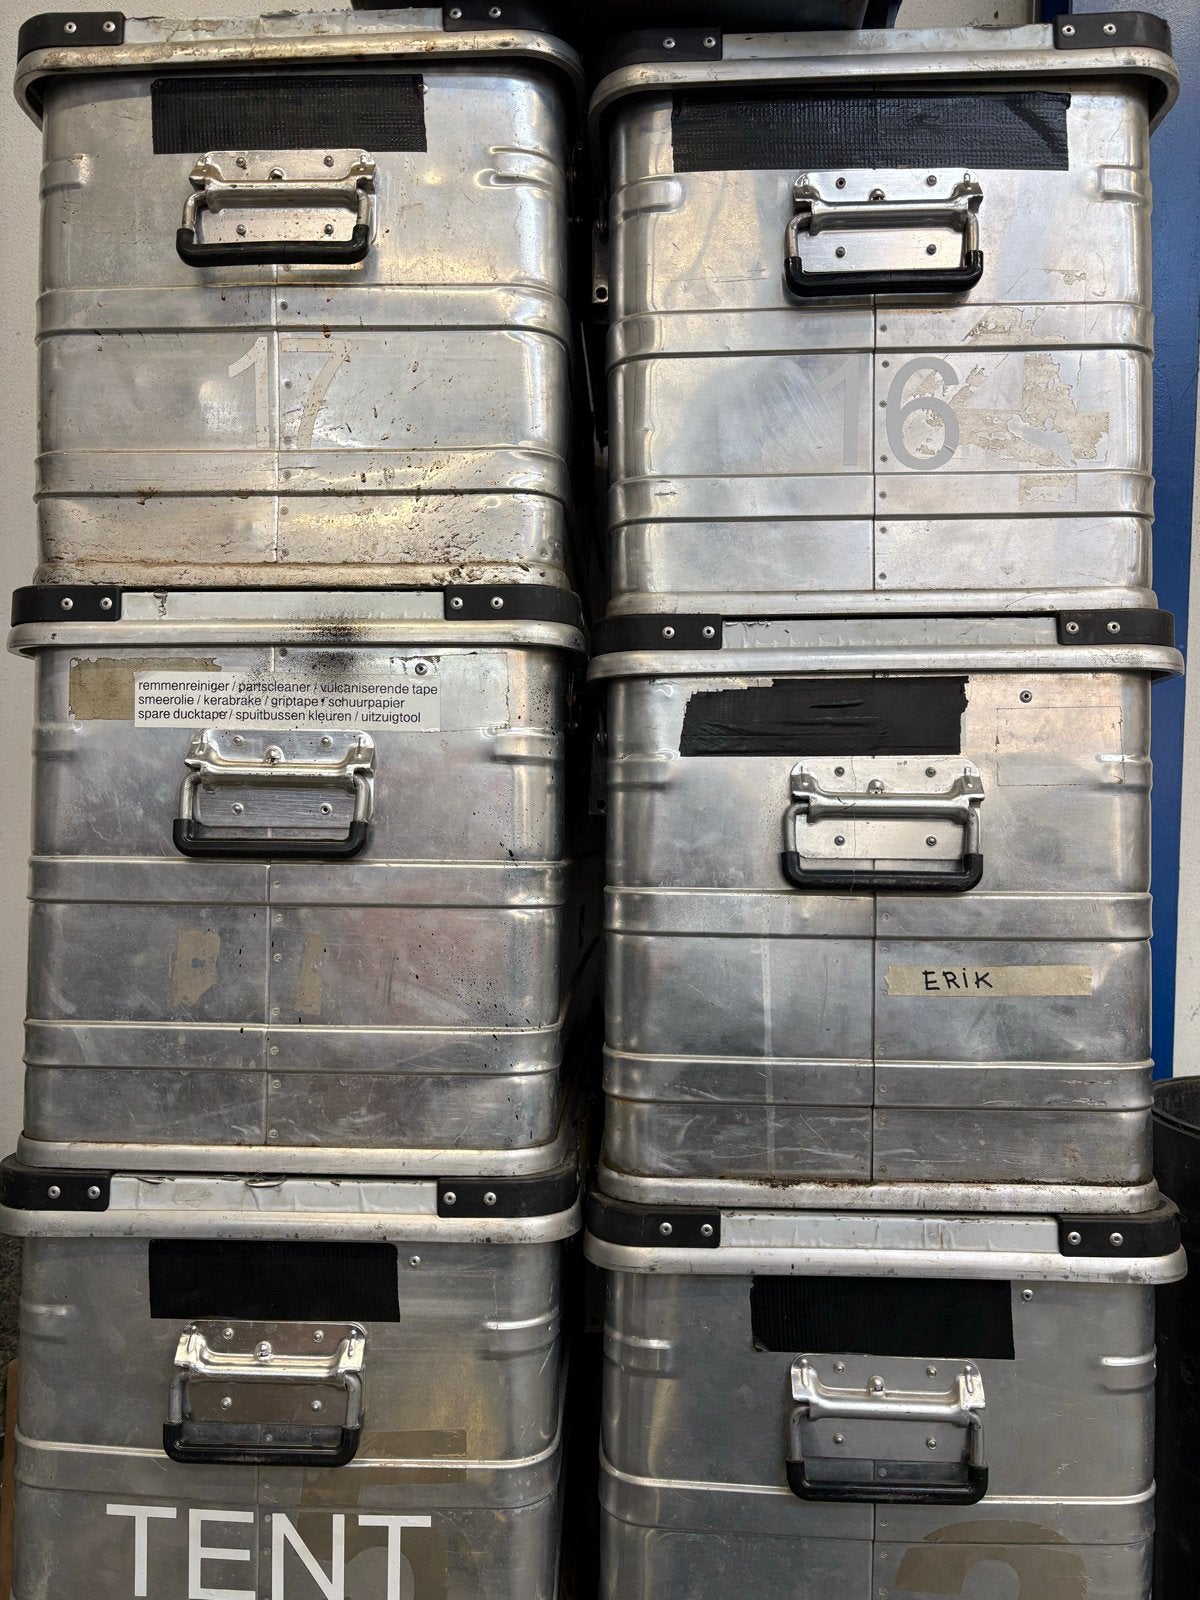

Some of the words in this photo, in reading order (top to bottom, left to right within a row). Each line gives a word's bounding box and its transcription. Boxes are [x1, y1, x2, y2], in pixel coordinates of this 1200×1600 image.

[228, 336, 352, 448] 17
[817, 356, 960, 471] 16
[138, 680, 230, 692] remmenreiniger
[238, 681, 311, 694] partscleaner
[320, 682, 409, 695] vulcaniserende
[412, 684, 438, 697] tape
[138, 694, 194, 706] smeerolie
[203, 694, 262, 706] kerabrake
[271, 696, 319, 708] griptape
[328, 697, 405, 710] schuurpapier
[138, 709, 170, 721] spare
[173, 708, 227, 722] ducktape
[235, 710, 306, 722] spuitbussen
[308, 710, 352, 722] kleuren
[361, 710, 421, 724] uitzuigtool
[106, 1503, 432, 1600] TENT
